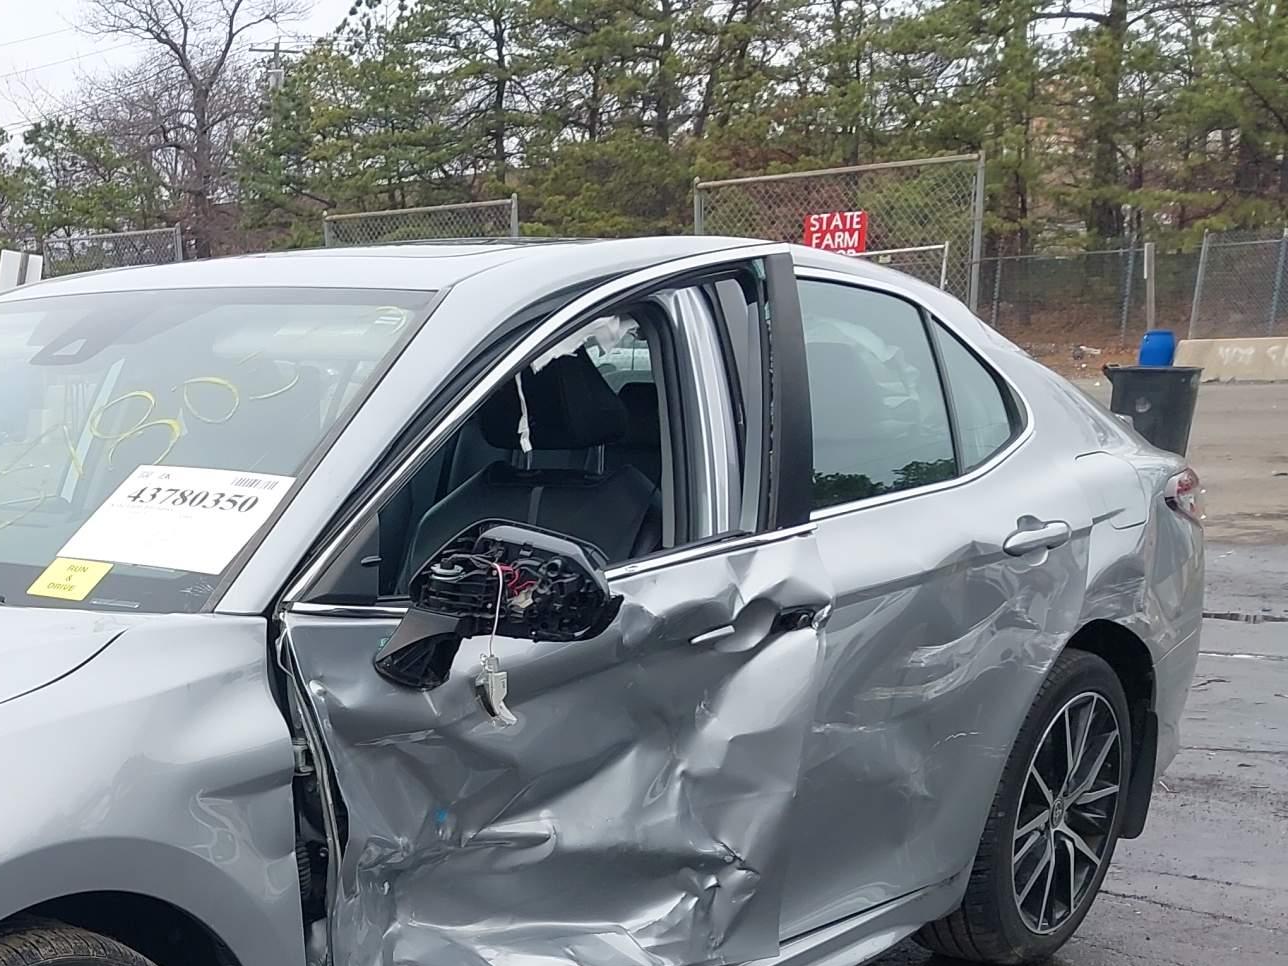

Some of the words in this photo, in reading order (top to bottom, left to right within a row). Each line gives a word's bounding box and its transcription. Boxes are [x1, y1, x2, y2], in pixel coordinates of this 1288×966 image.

[809, 211, 863, 231] STATE
[812, 231, 859, 249] FARM
[127, 486, 260, 513] 43780350
[66, 564, 89, 573] RUN
[46, 582, 76, 592] DRIVE
